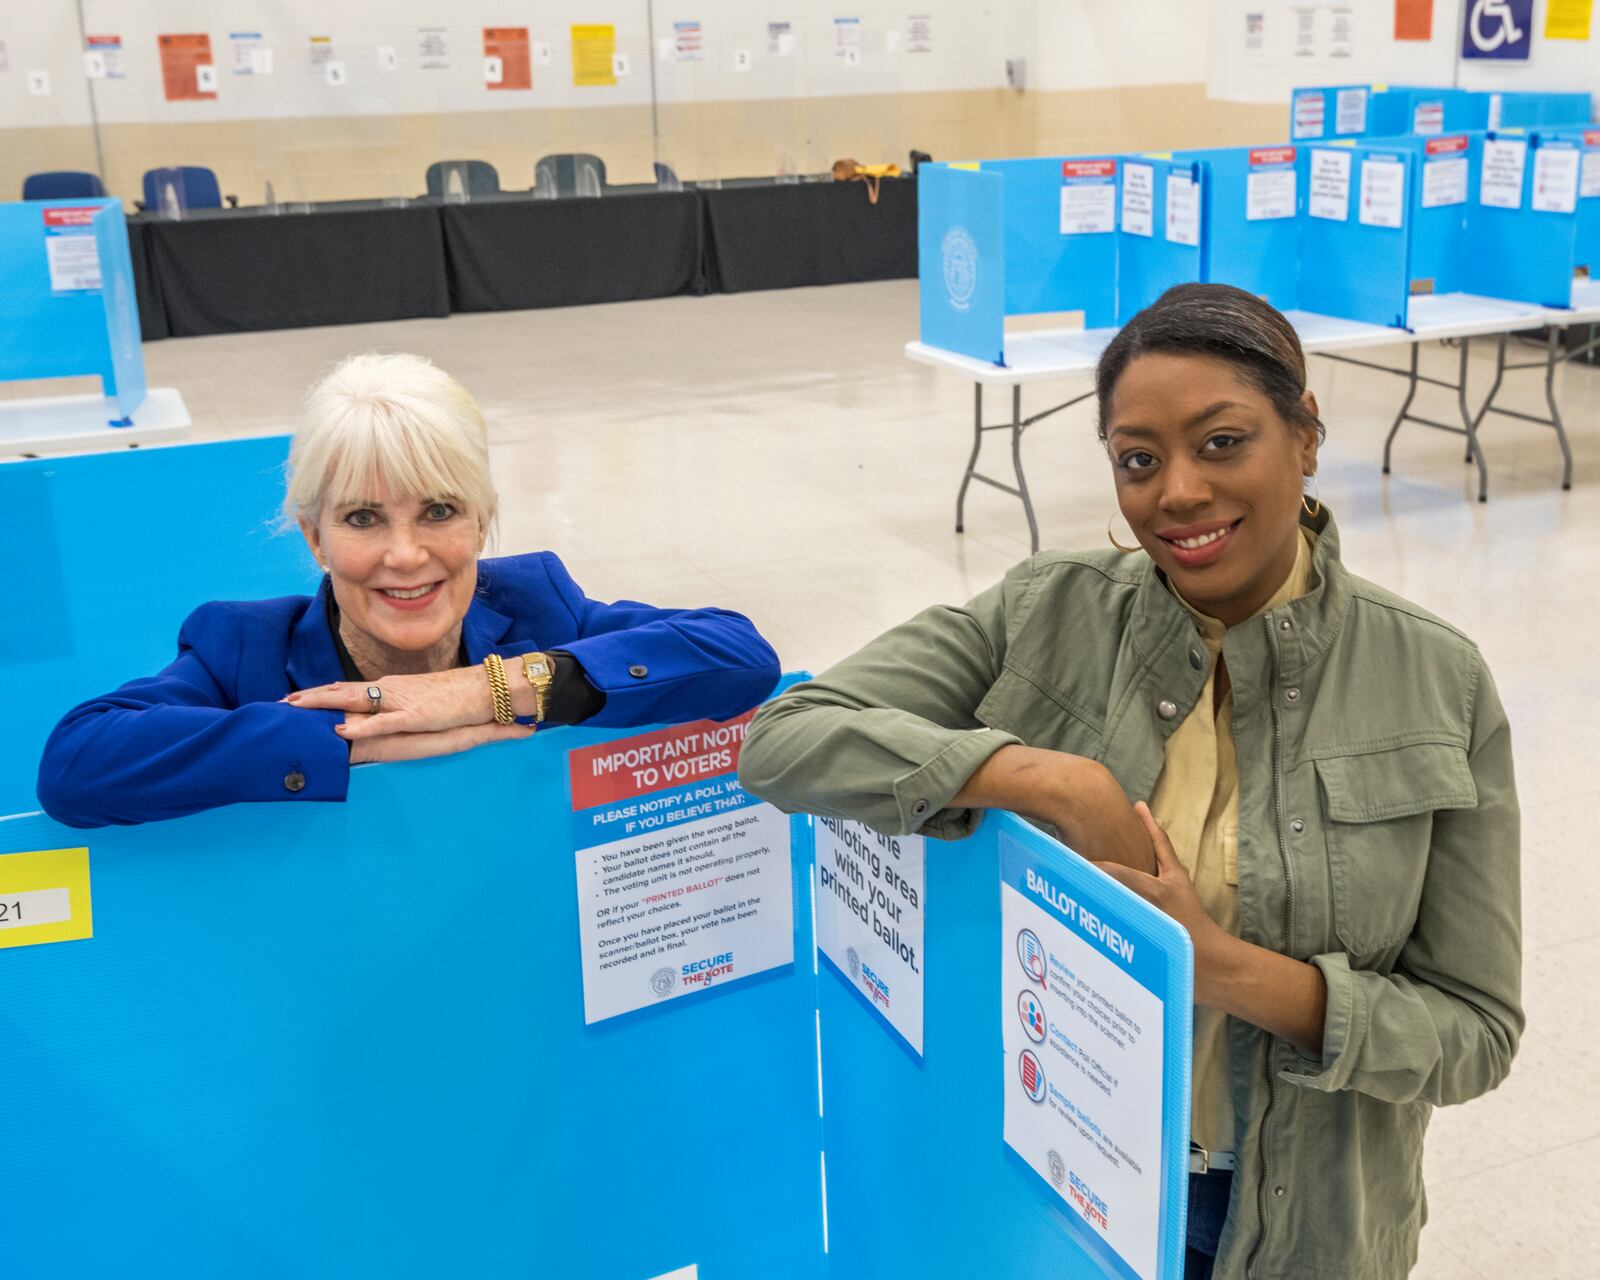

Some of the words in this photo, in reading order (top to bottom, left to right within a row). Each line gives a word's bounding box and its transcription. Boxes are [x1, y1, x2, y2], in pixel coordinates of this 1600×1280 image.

[592, 734, 699, 776] IMPORTANT
[632, 767, 658, 788] TO
[661, 749, 731, 781] VOTERS
[593, 805, 637, 825] PLEASE
[639, 794, 682, 813] NOTIFY
[684, 792, 693, 802] A
[695, 784, 723, 800] POLL
[625, 821, 636, 833] IF
[638, 814, 664, 829] YOU
[666, 802, 712, 822] BELIEVE
[714, 793, 745, 809] THAT:
[602, 864, 621, 873] Your
[624, 856, 648, 868] ballot
[650, 851, 670, 861] does
[673, 846, 686, 855] not
[689, 838, 719, 851] contain
[721, 834, 730, 842] all
[732, 831, 745, 839] the
[620, 847, 640, 857] have
[643, 841, 664, 851] been
[666, 835, 689, 847] given
[691, 831, 704, 839] the
[706, 823, 732, 834] wrong
[596, 908, 609, 917] OR
[612, 905, 618, 913] if
[620, 901, 638, 913] your
[725, 872, 744, 882] does
[746, 867, 760, 876] not
[603, 869, 645, 885] candidate
[647, 861, 675, 873] names
[603, 887, 619, 896] The
[622, 879, 648, 891] voting
[651, 873, 667, 883] unit
[678, 867, 692, 876] not
[694, 856, 733, 871] operating
[834, 848, 863, 890] with
[868, 880, 901, 923] your
[885, 865, 918, 909] area
[0, 901, 22, 922] 21
[597, 916, 624, 928] reflect
[626, 911, 645, 922] your
[598, 937, 621, 947] Once
[623, 932, 638, 942] you
[641, 926, 661, 935] have
[663, 916, 691, 930] placed
[692, 911, 711, 922] your
[713, 903, 736, 915] ballot
[747, 897, 760, 905] the
[820, 865, 868, 924] printed
[873, 910, 918, 974] ballot.
[1026, 869, 1076, 920] BALLOT
[1079, 907, 1134, 962] REVIEW
[599, 936, 659, 959] scanner/ballot
[680, 925, 698, 937] your
[701, 920, 719, 929] vote
[737, 909, 757, 919] been
[599, 953, 637, 969] recorded
[640, 948, 655, 958] and
[682, 951, 732, 975] SECURE
[682, 972, 705, 985] THE
[1049, 953, 1075, 980] Review
[862, 963, 889, 997] SECURE
[1049, 1022, 1077, 1053] Contact
[1049, 1083, 1075, 1113] Sample
[1077, 1108, 1101, 1137] ballots
[1069, 1171, 1107, 1216] SECURE
